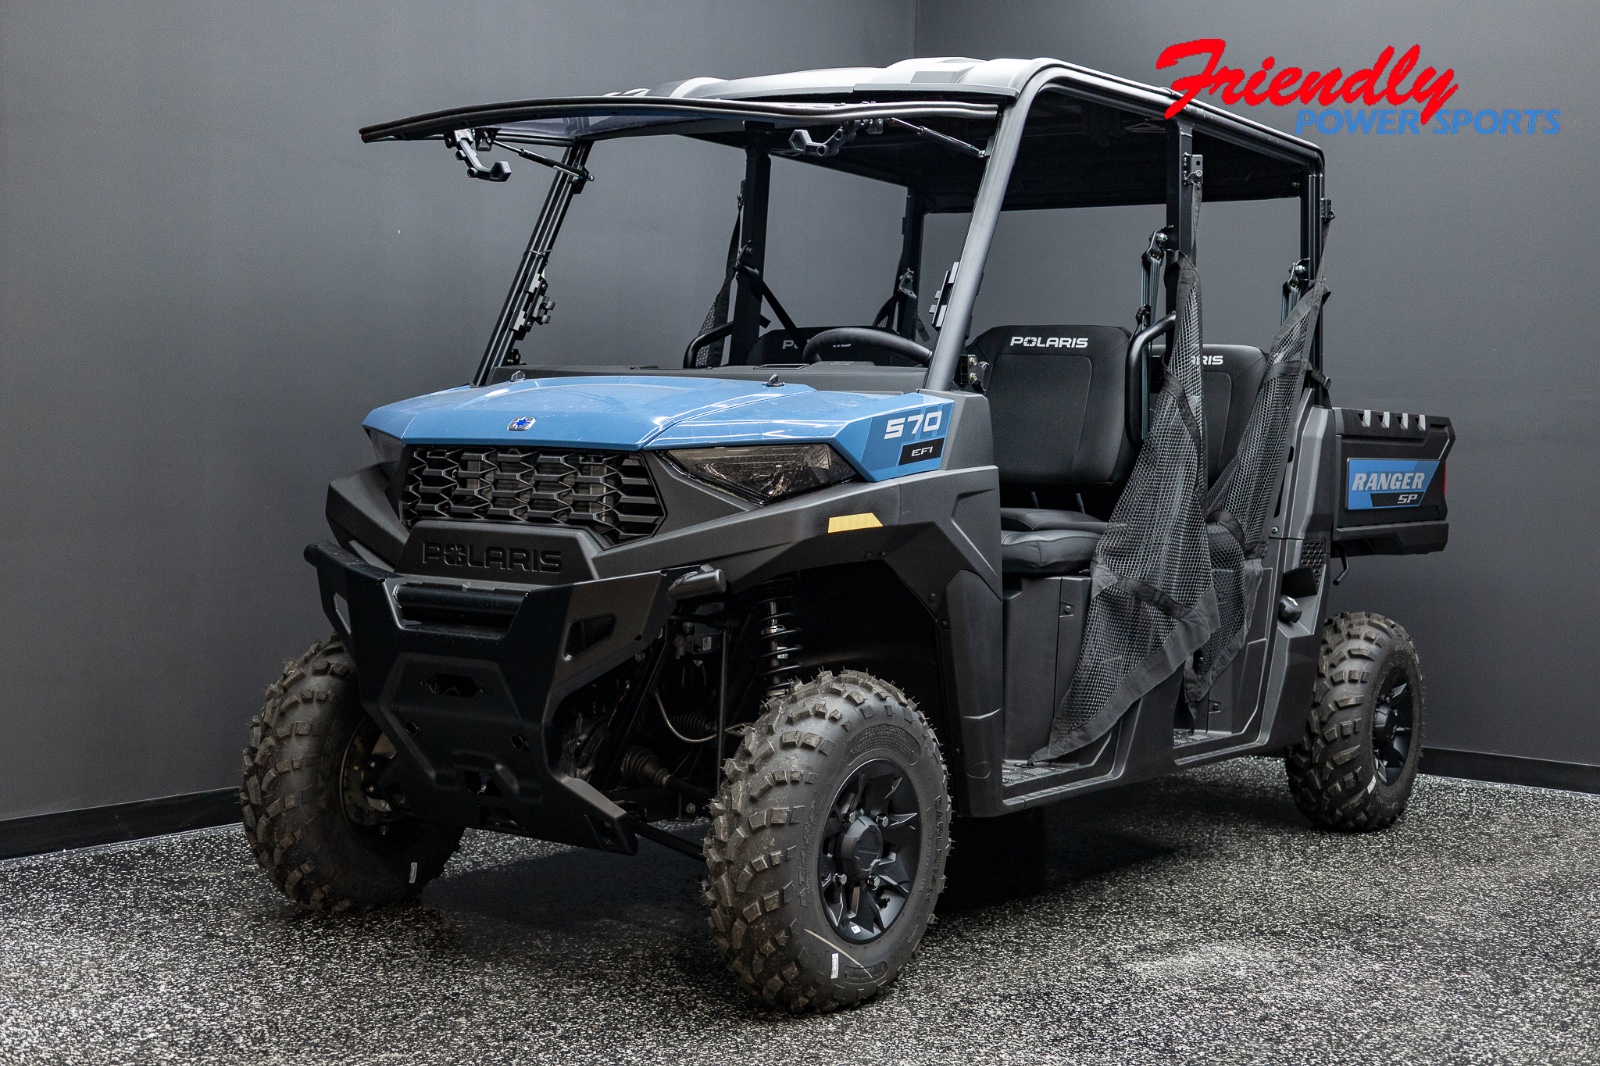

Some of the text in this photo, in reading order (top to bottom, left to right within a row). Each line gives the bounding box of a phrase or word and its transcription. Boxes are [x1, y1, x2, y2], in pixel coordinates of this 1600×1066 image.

[1010, 336, 1089, 349] POLARIS
[884, 411, 943, 440] 570
[911, 446, 933, 457] EFI
[1352, 472, 1425, 491] RANGER
[1397, 494, 1418, 504] SP
[422, 541, 563, 574] POLARIS
